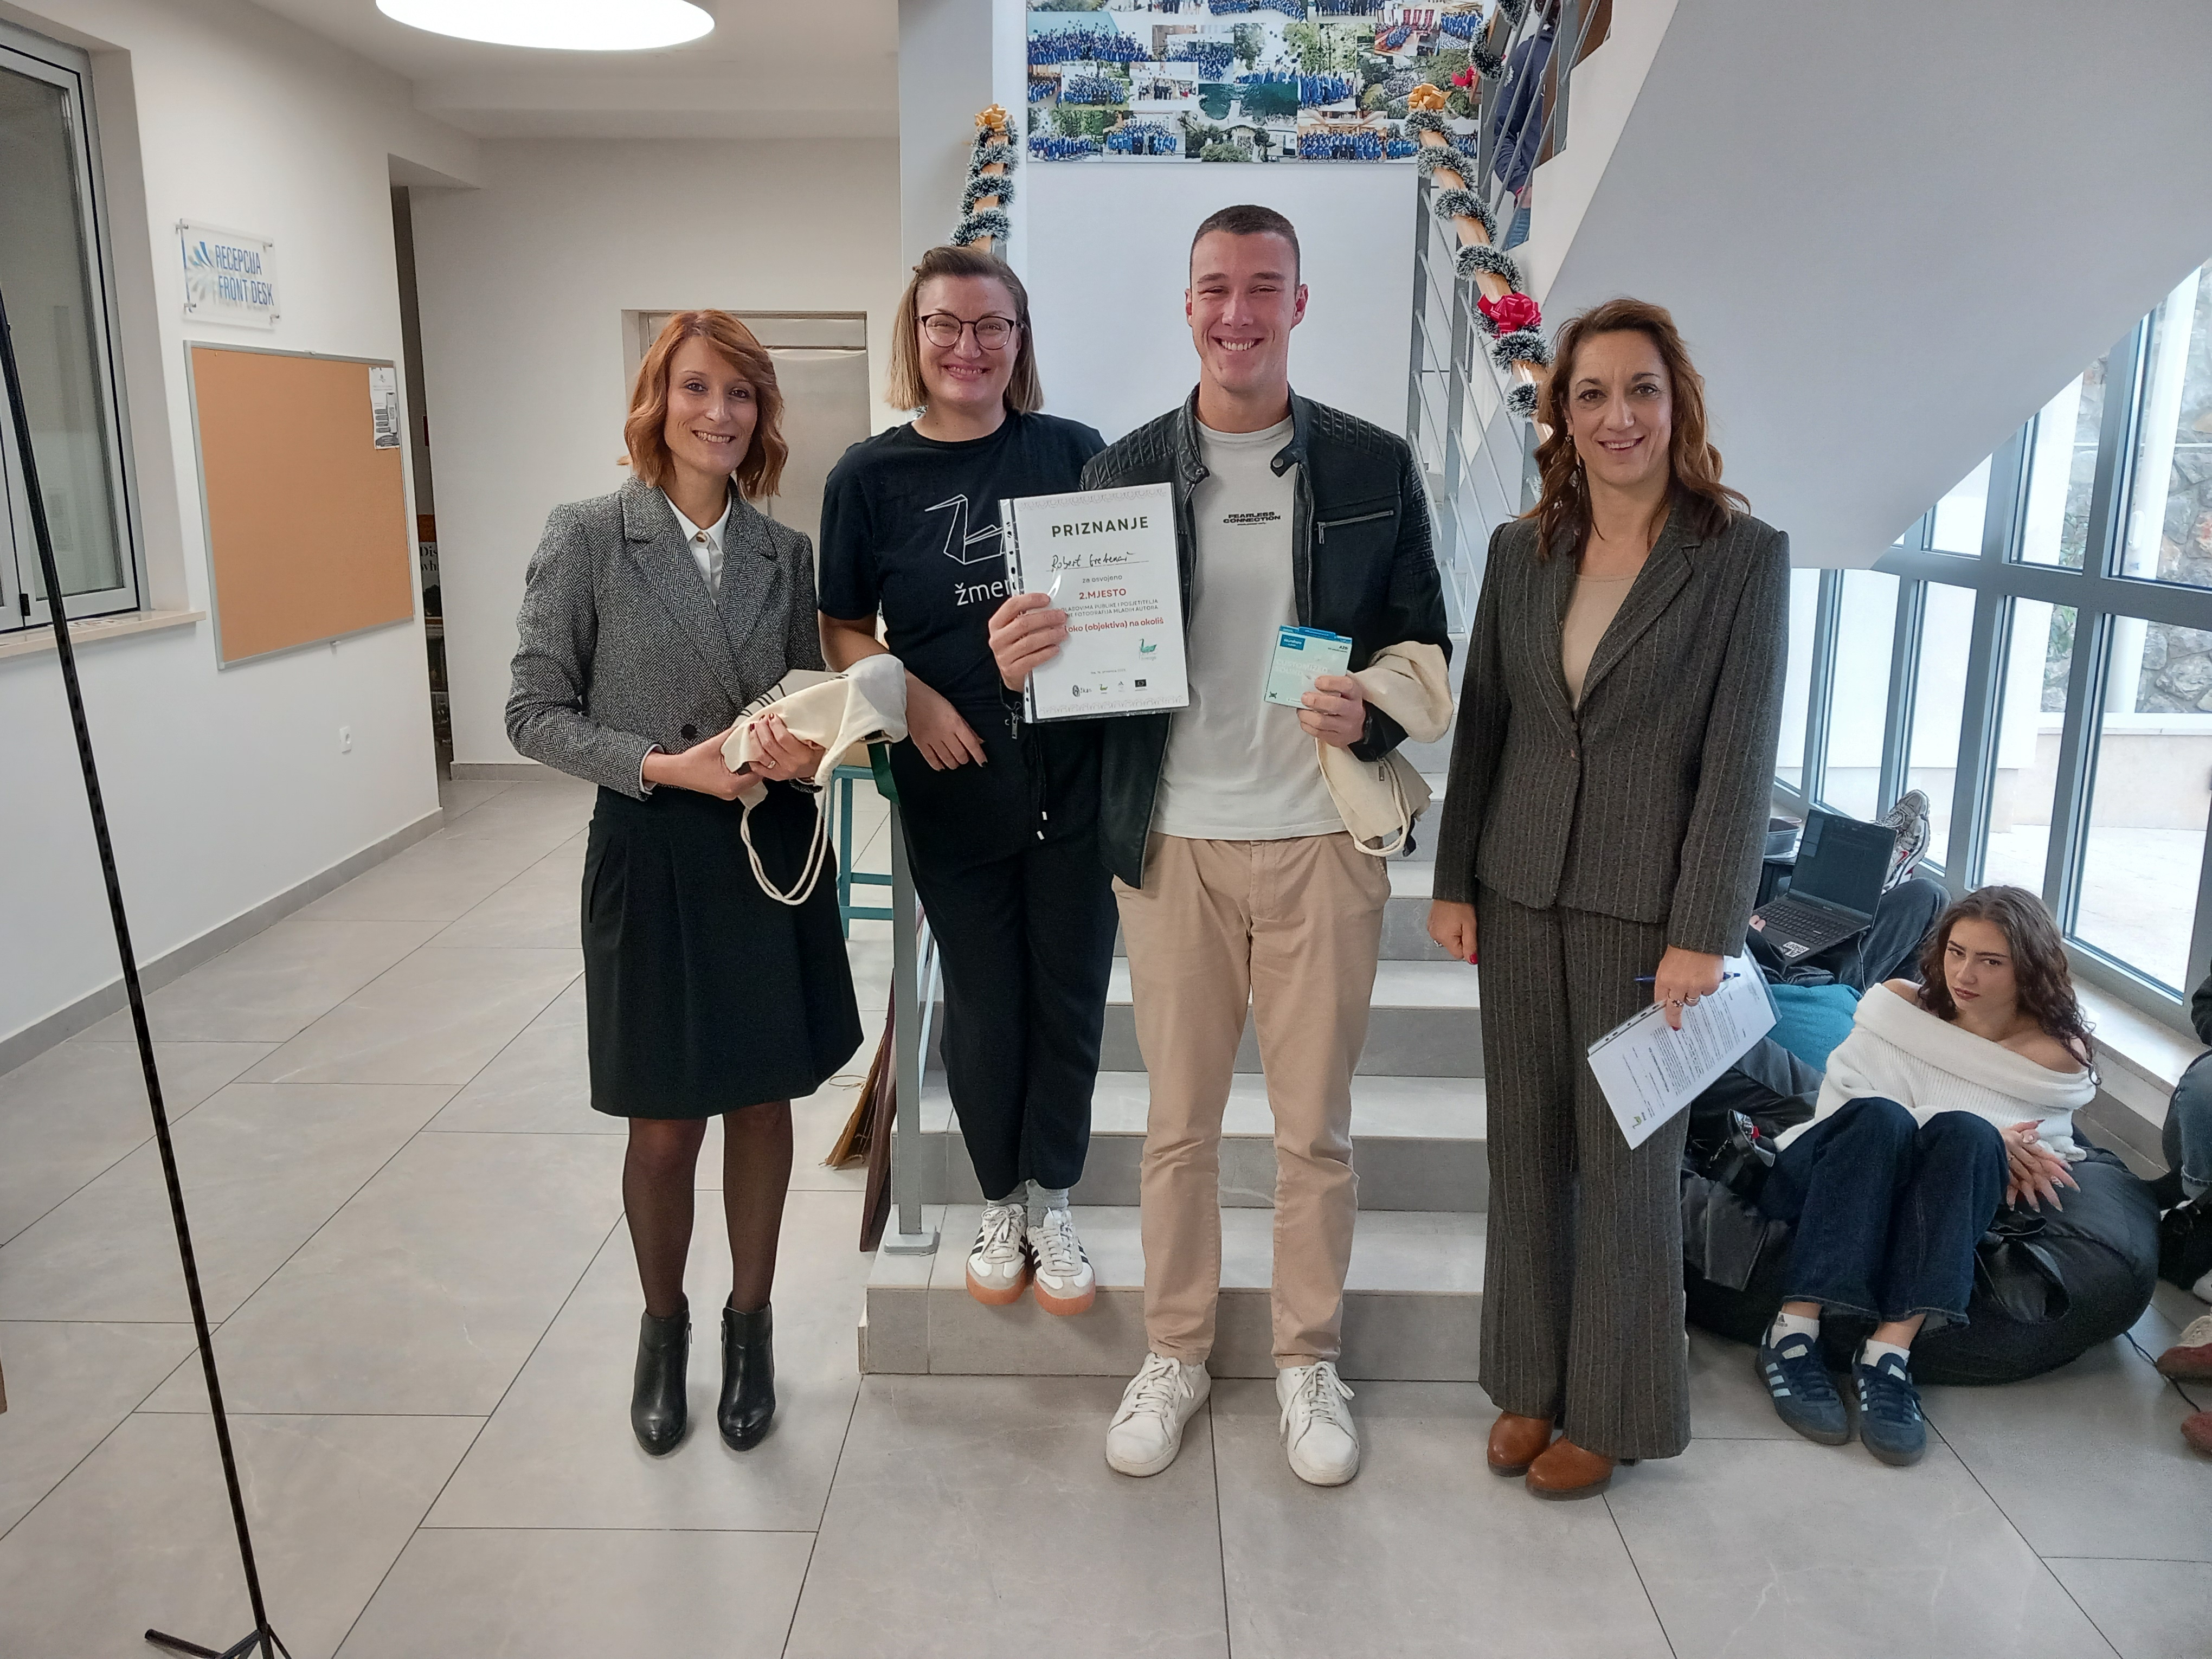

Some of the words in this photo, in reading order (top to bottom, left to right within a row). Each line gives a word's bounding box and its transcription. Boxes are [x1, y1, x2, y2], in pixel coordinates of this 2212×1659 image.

[215, 245, 262, 275] RECEPCIJA
[218, 275, 248, 303] FRONT
[250, 280, 274, 306] DESK
[1052, 516, 1148, 537] PRIZNANJE
[1223, 515, 1281, 523] CONNECTION
[1079, 588, 1127, 600] 2.MJESTO
[1085, 620, 1128, 632] (objektiva)
[1140, 617, 1164, 625] okoliš
